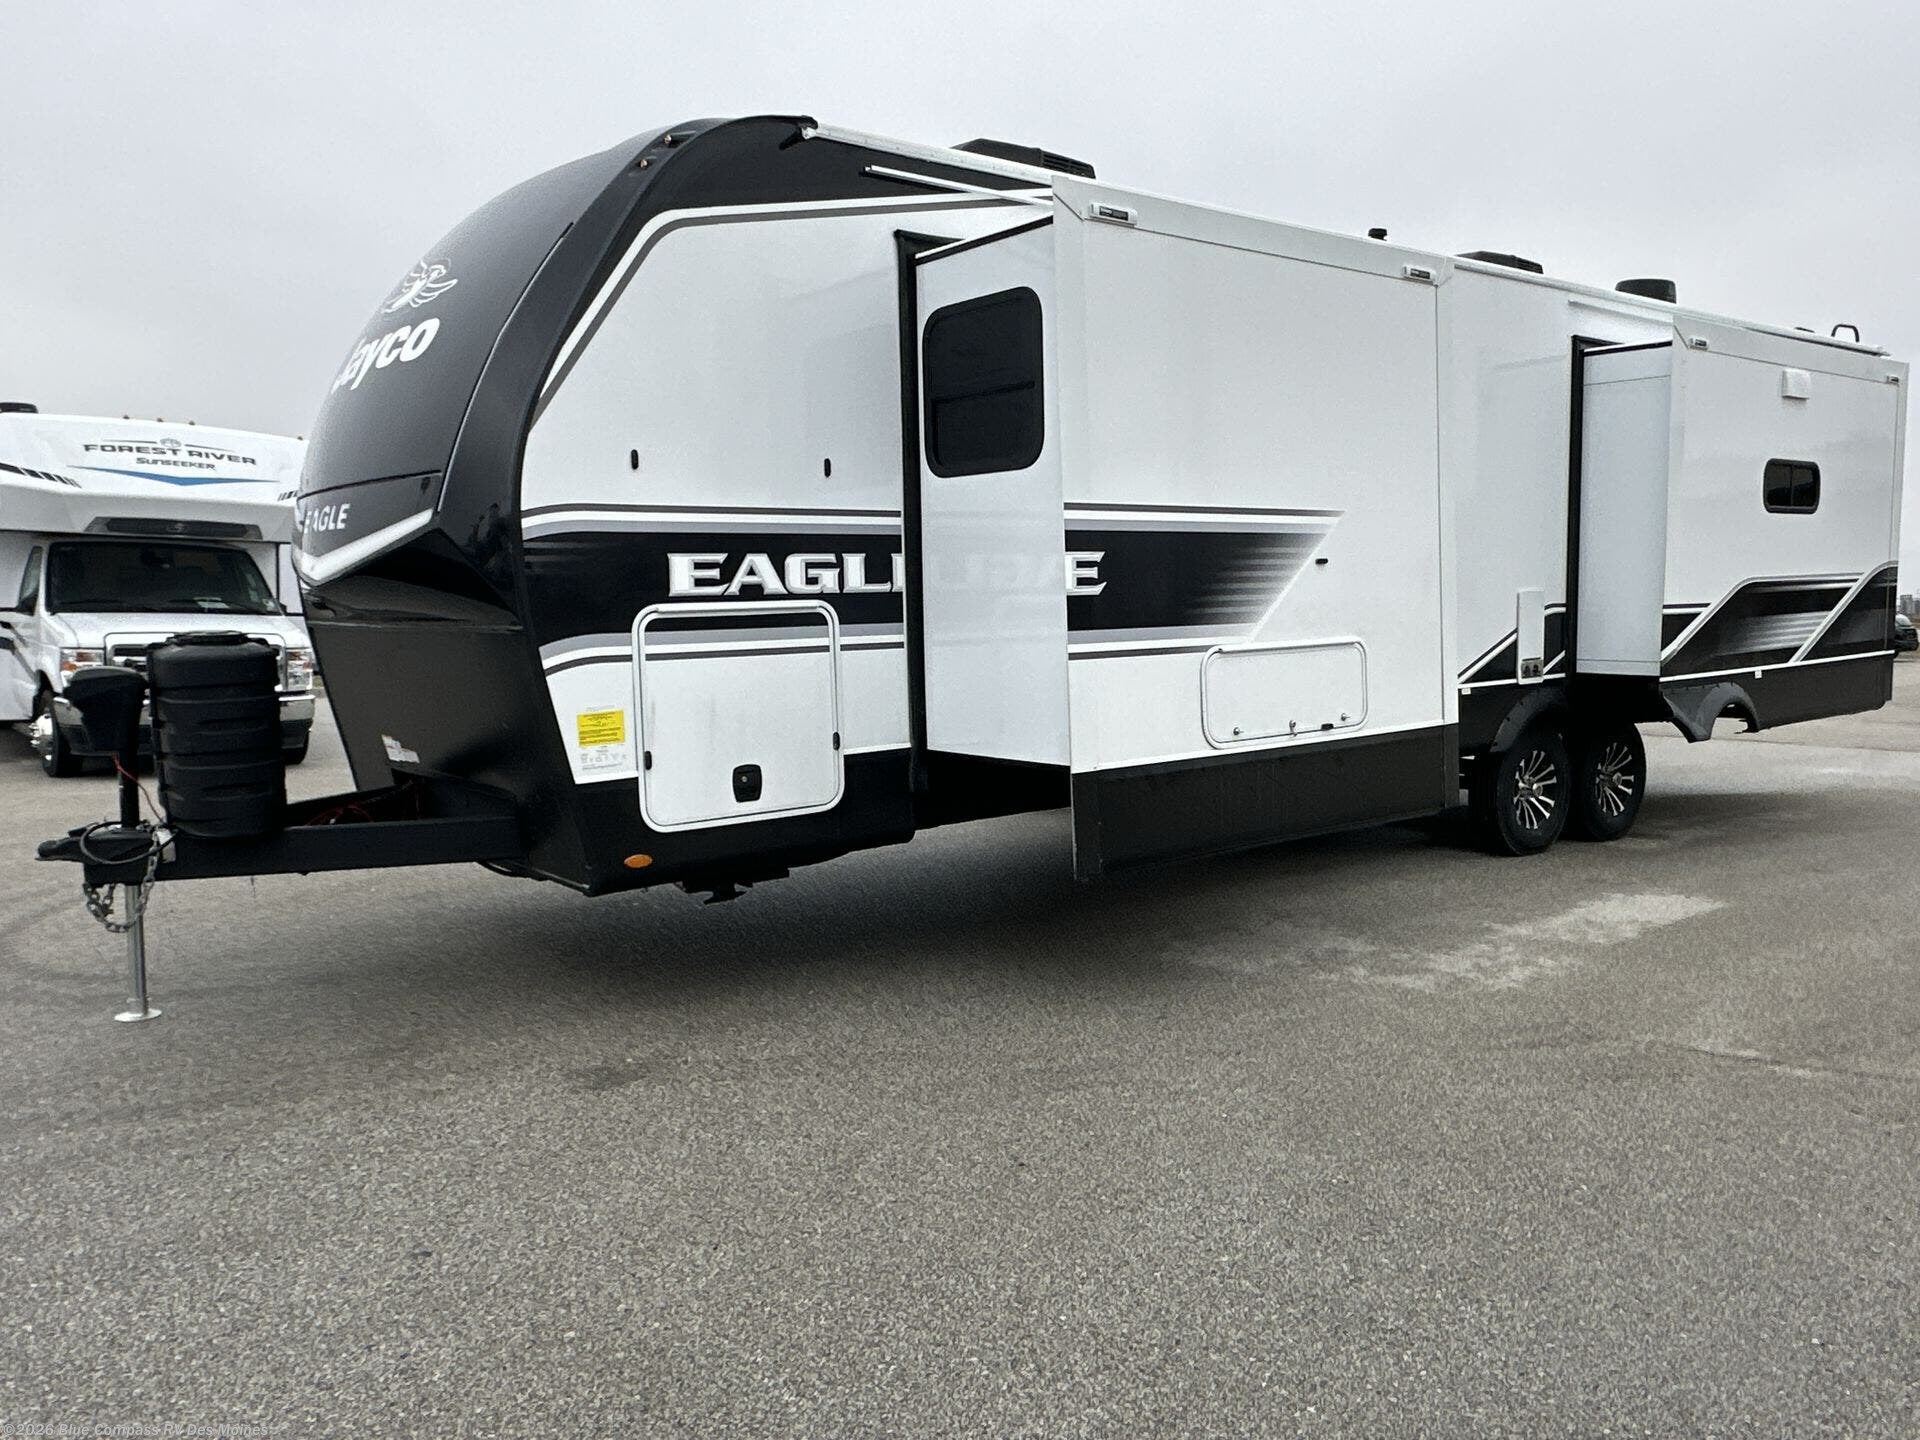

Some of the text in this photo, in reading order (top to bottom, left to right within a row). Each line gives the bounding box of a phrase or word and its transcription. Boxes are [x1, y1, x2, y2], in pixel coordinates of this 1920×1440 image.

[83, 443, 257, 466] FOREST RIVER
[303, 503, 351, 535] EAGLE
